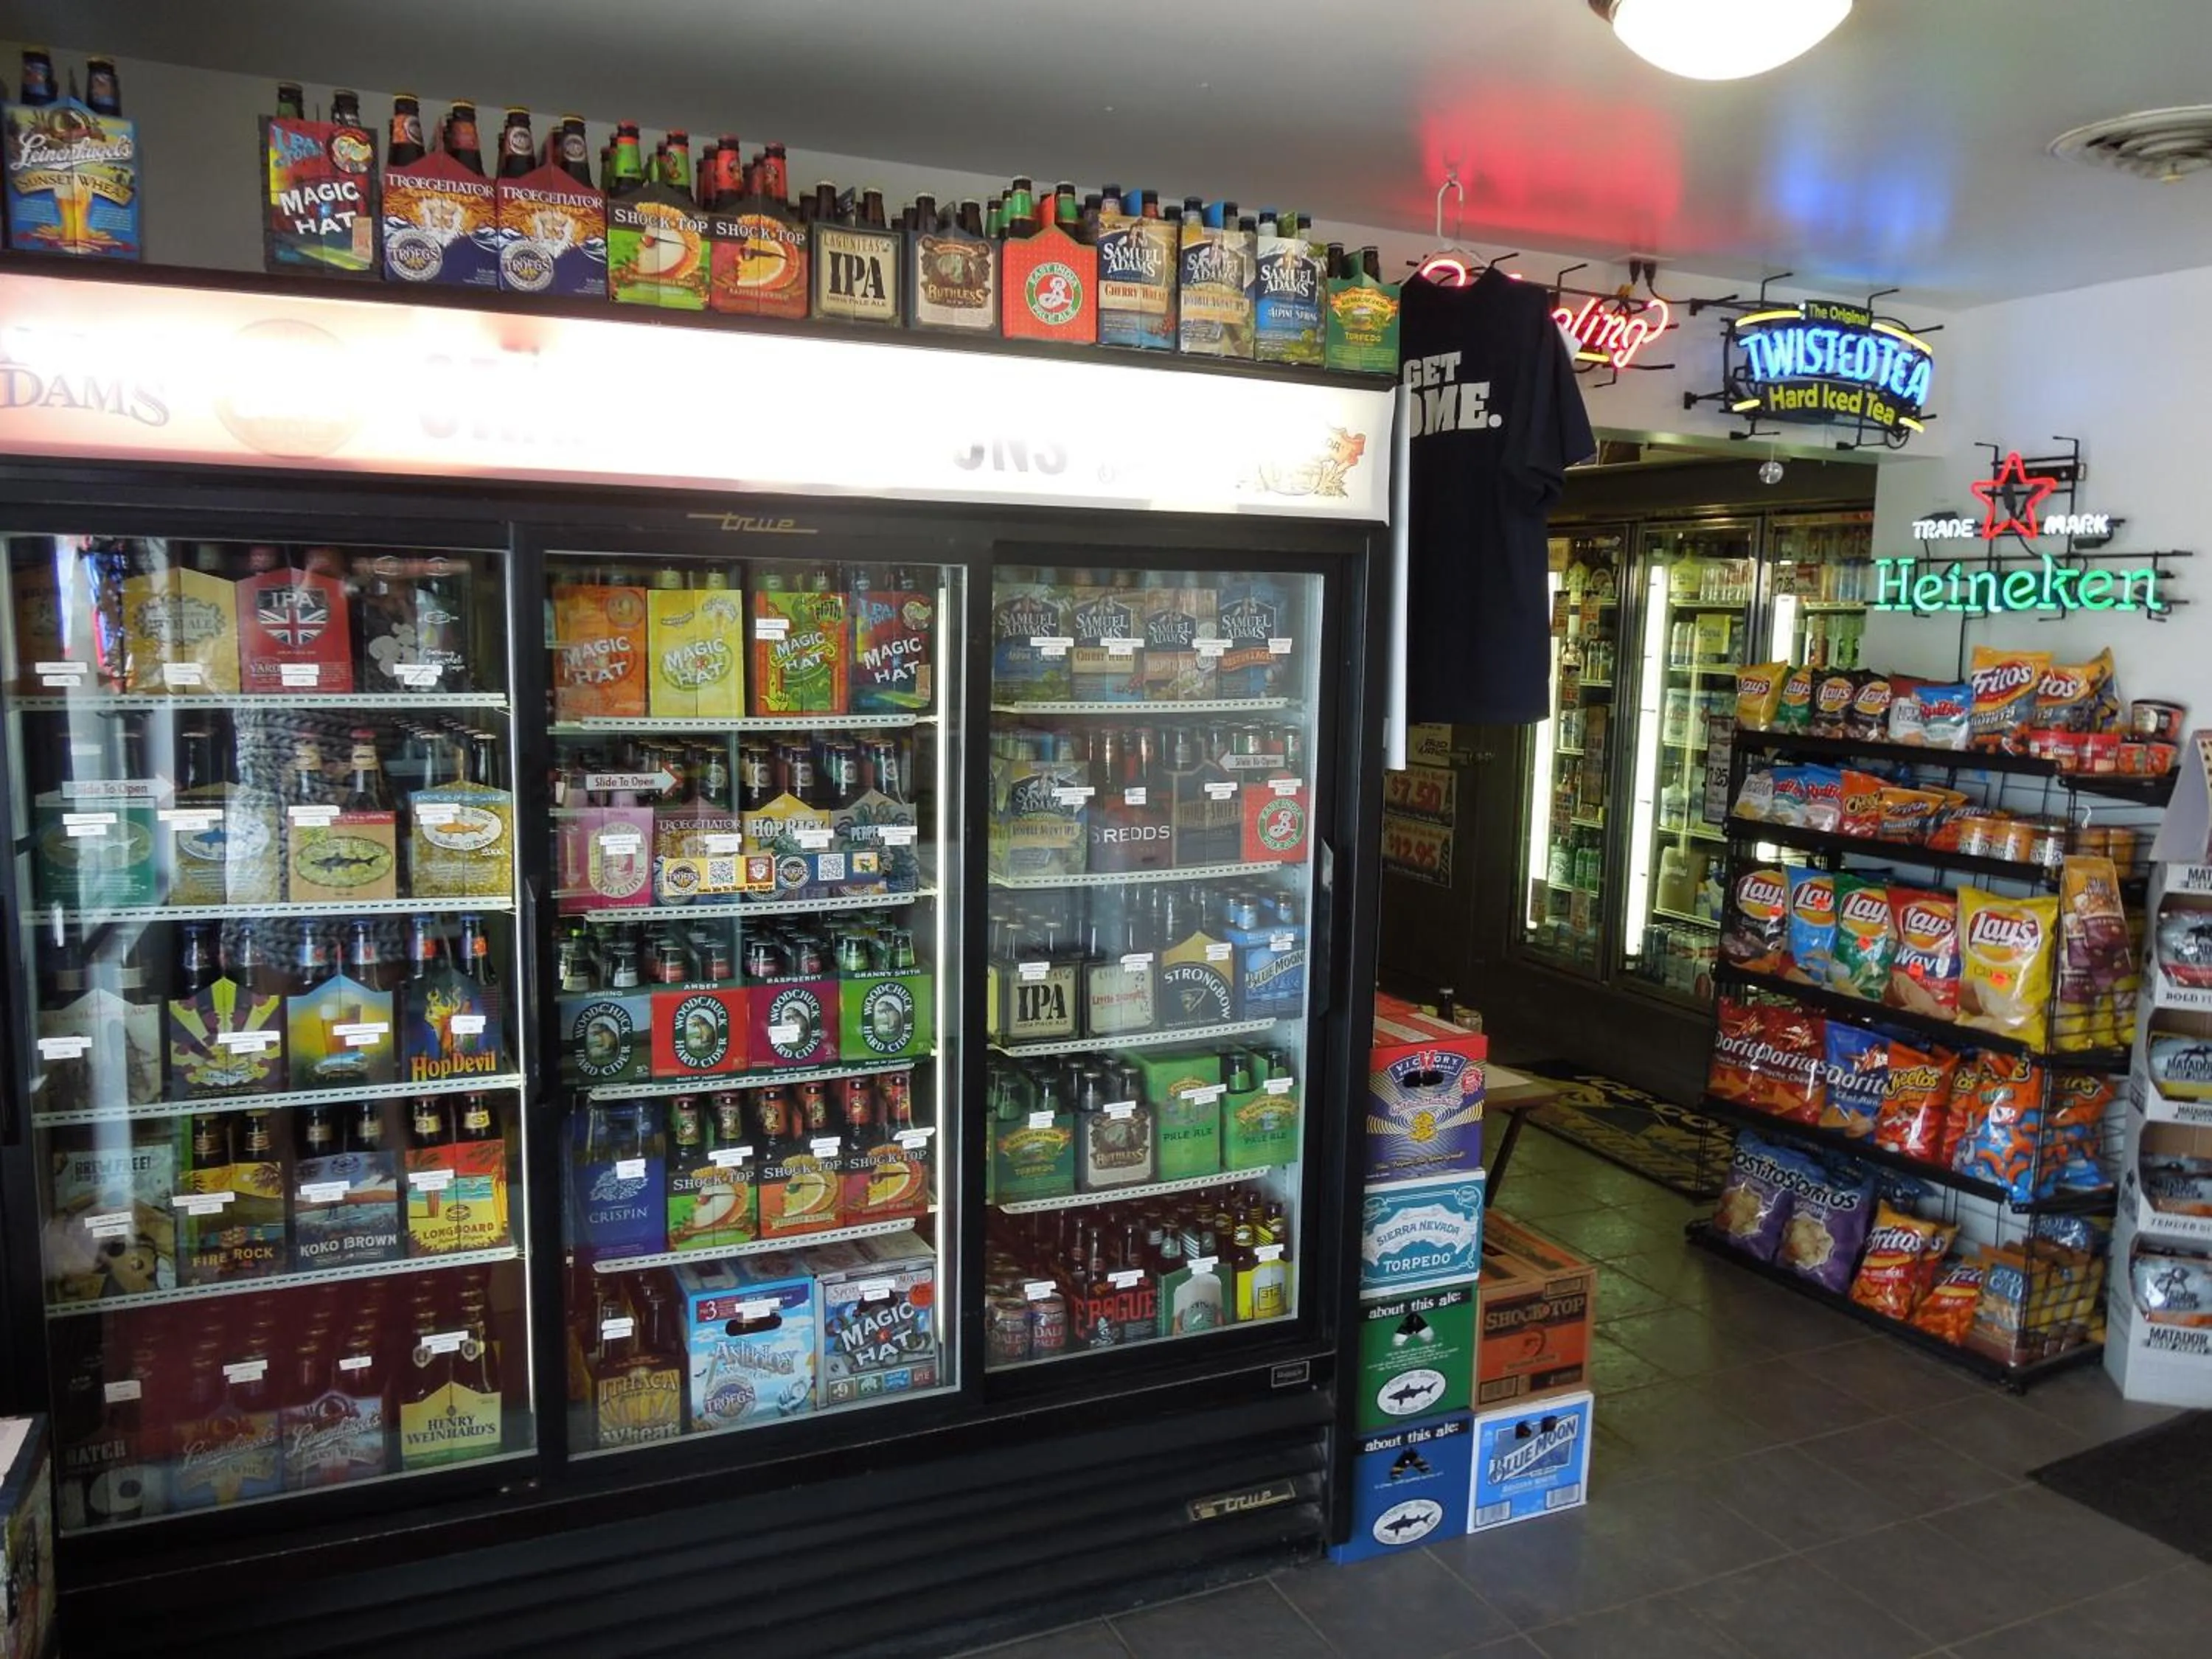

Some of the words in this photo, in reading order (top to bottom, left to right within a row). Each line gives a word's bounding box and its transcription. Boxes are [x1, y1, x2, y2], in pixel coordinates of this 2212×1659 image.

[279, 180, 360, 218] MAGIC
[296, 210, 358, 236] HAT
[614, 207, 672, 230] SHOCK
[675, 215, 709, 235] TOP
[715, 220, 772, 242] SHOCK
[776, 229, 806, 246] TOP
[1101, 240, 1162, 267] SAMUEL
[828, 251, 886, 300] IPA
[1107, 257, 1156, 279] ADAMS
[1191, 267, 1236, 284] ADAMS
[1260, 265, 1314, 286] SAMUEL
[928, 284, 986, 304] RUTHLESS
[1264, 277, 1309, 297] ADAMS
[1808, 302, 1828, 320] The
[1829, 304, 1871, 329] Original
[1402, 350, 1463, 389] GET
[0, 366, 170, 427] DAMS
[1768, 384, 1818, 414] Hard
[1822, 386, 1863, 411] Iced
[1865, 393, 1895, 427] Tea
[1410, 381, 1503, 439] OME.
[1911, 518, 1975, 540] TRADE
[2043, 513, 2109, 536] MARK
[1874, 554, 2163, 614] Heineken
[271, 591, 316, 609] IPA
[998, 610, 1057, 627] SAMUEL
[1075, 613, 1129, 629] SAMUEL
[1148, 621, 1192, 636] SAMUEL
[1221, 613, 1272, 629] SAMUEL
[1003, 625, 1051, 638] ADAMS
[1079, 626, 1122, 639] ADAMS
[1151, 633, 1189, 646] ADAMS
[1226, 626, 1266, 640] ADAMS
[561, 636, 631, 668] MAGIC
[664, 638, 727, 672] MAGIC
[776, 631, 826, 658] MAGIC
[863, 637, 922, 670] MAGIC
[249, 663, 282, 676] YARD
[784, 651, 824, 672] HAT
[874, 661, 920, 684] HAT
[676, 662, 726, 686] HAT
[1971, 664, 2033, 695] Fritos
[1739, 678, 1770, 695] Lay's
[1818, 683, 1852, 702] Lay's
[1857, 686, 1891, 706] Lay's
[2038, 677, 2078, 698] tos
[594, 776, 617, 787] Slide
[619, 776, 630, 787] To
[631, 776, 656, 788] Open
[751, 818, 784, 838] HOP
[1972, 913, 2039, 947] Lay's
[766, 974, 822, 984] RASPBERRY
[769, 988, 821, 1023] WOODCHUCK
[863, 983, 914, 1016] WOODCHUCK
[1016, 983, 1068, 1022] IPA
[1164, 967, 1231, 1020] STRONGBOW
[2166, 991, 2199, 1004] BOLD
[574, 1002, 631, 1039] WOODCHUCK
[675, 995, 728, 1031] WOODCHUCK
[794, 1029, 821, 1060] CIDER
[863, 1026, 886, 1053] HARD
[887, 1023, 913, 1053] CIDER
[574, 1048, 599, 1077] HARD
[601, 1044, 631, 1077] CIDER
[675, 1040, 698, 1068] HARD
[700, 1037, 728, 1068] CIDER
[2166, 1060, 2212, 1074] MATADO
[1193, 1127, 1213, 1137] ALE
[763, 1164, 813, 1179] SHOCK
[818, 1159, 843, 1172] TOP
[849, 1155, 898, 1169] SHOCK
[902, 1150, 927, 1162] TOP
[672, 1176, 723, 1192] SHOCK
[728, 1170, 755, 1182] TOP
[589, 1206, 649, 1224] CRISPIN
[422, 1221, 495, 1240] LONGBOARD
[1376, 1222, 1418, 1246] SIERRA
[1419, 1220, 1461, 1237] NEVADA
[1867, 1227, 1924, 1253] Fritos
[192, 1251, 227, 1268] FIRE
[233, 1246, 274, 1261] ROCK
[299, 1239, 340, 1258] KOKO
[344, 1234, 398, 1251] BROWN
[1382, 1253, 1452, 1273] TORPEDO
[1368, 1301, 1405, 1319] about
[1411, 1296, 1435, 1312] this
[1438, 1290, 1462, 1307] ale:
[1484, 1304, 1545, 1332] SHOCK
[1551, 1295, 1585, 1318] TOP
[841, 1301, 915, 1352] MAGIC
[2149, 1327, 2209, 1347] MATADOR
[855, 1329, 912, 1366] HAT
[601, 1371, 677, 1404] ITHACA
[406, 1423, 497, 1446] WEINHARD'S
[427, 1415, 475, 1432] HENRY
[1364, 1435, 1402, 1453] about
[1407, 1429, 1431, 1445] this
